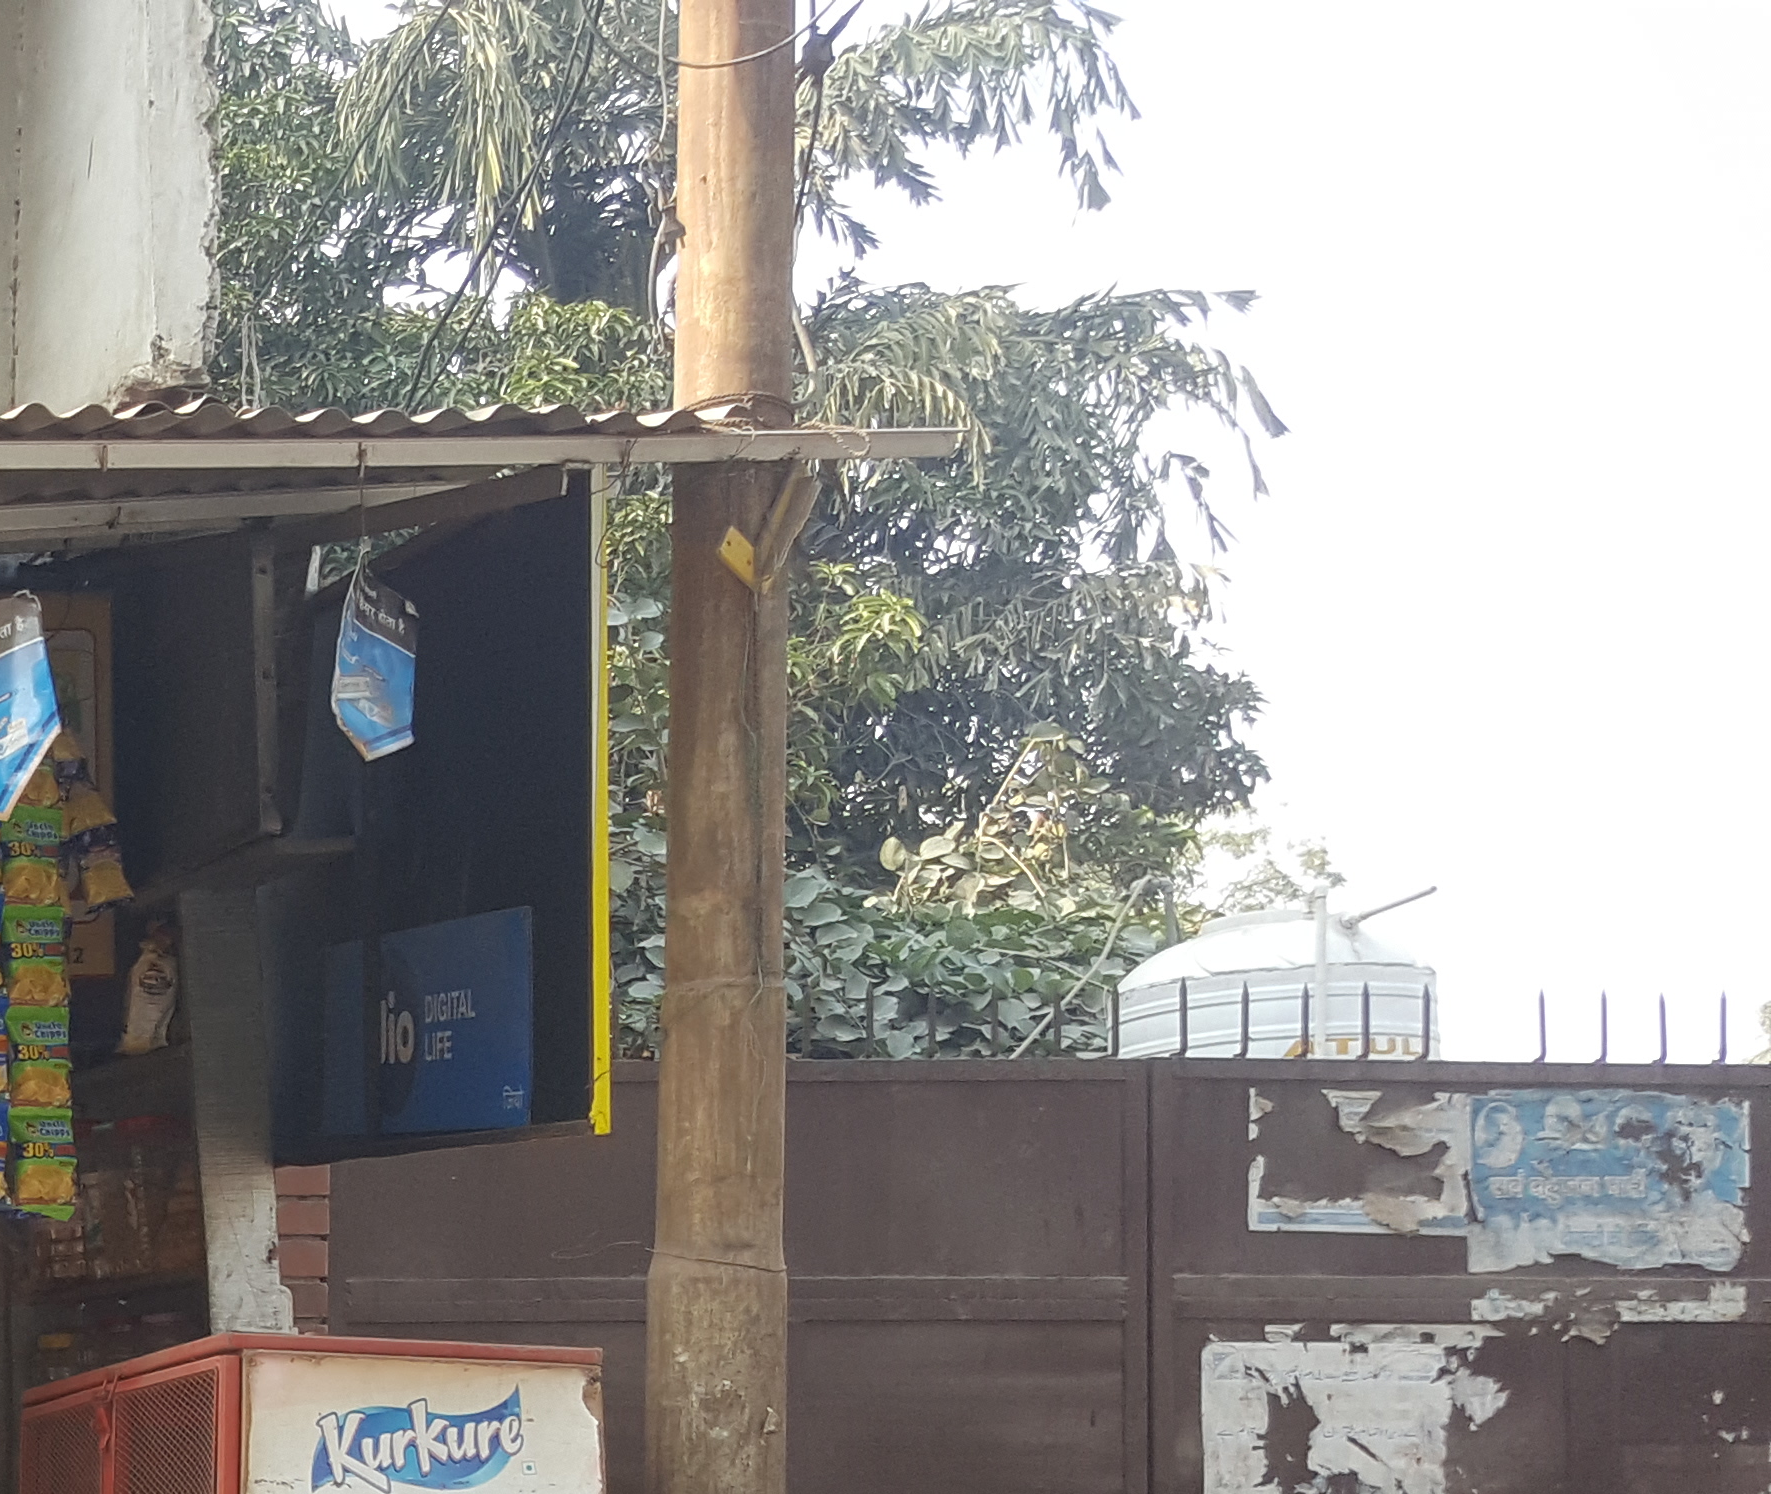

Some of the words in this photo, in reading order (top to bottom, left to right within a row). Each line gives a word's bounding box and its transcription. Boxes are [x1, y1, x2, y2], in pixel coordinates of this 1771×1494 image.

[424, 988, 476, 1023] DIGITAL
[424, 1030, 453, 1061] LIFE
[317, 1398, 524, 1494] Kurkure
